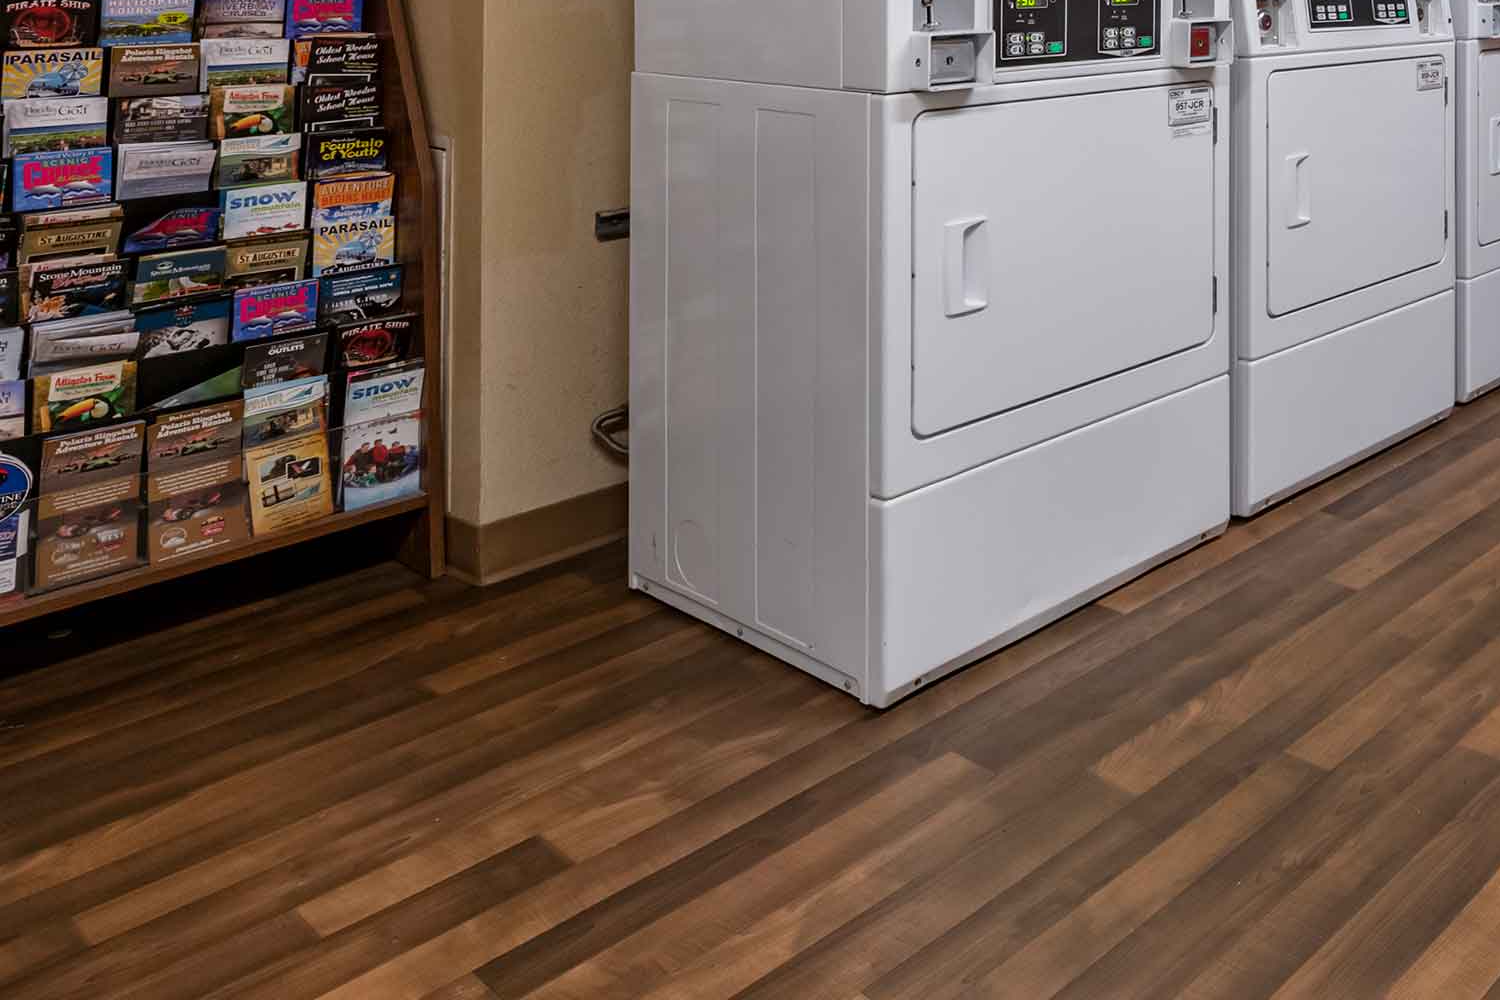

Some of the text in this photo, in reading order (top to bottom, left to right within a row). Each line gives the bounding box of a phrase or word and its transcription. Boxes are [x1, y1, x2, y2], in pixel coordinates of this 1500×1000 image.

[315, 46, 343, 55] Oldest
[316, 53, 346, 65] School
[314, 92, 341, 104] Oldest
[316, 99, 346, 113] School
[319, 138, 384, 153] Fountain
[322, 147, 379, 161] of Youth
[229, 191, 297, 210] snow
[320, 218, 392, 237] PARASAIL
[55, 230, 109, 243] AUGUSTINE
[251, 249, 298, 262] AUGUSTINE
[39, 264, 122, 282] Stone Mountain
[268, 343, 305, 356] OUTLETS
[351, 377, 416, 401] snow
[56, 440, 105, 455] Adventure
[59, 435, 93, 448] Polaris
